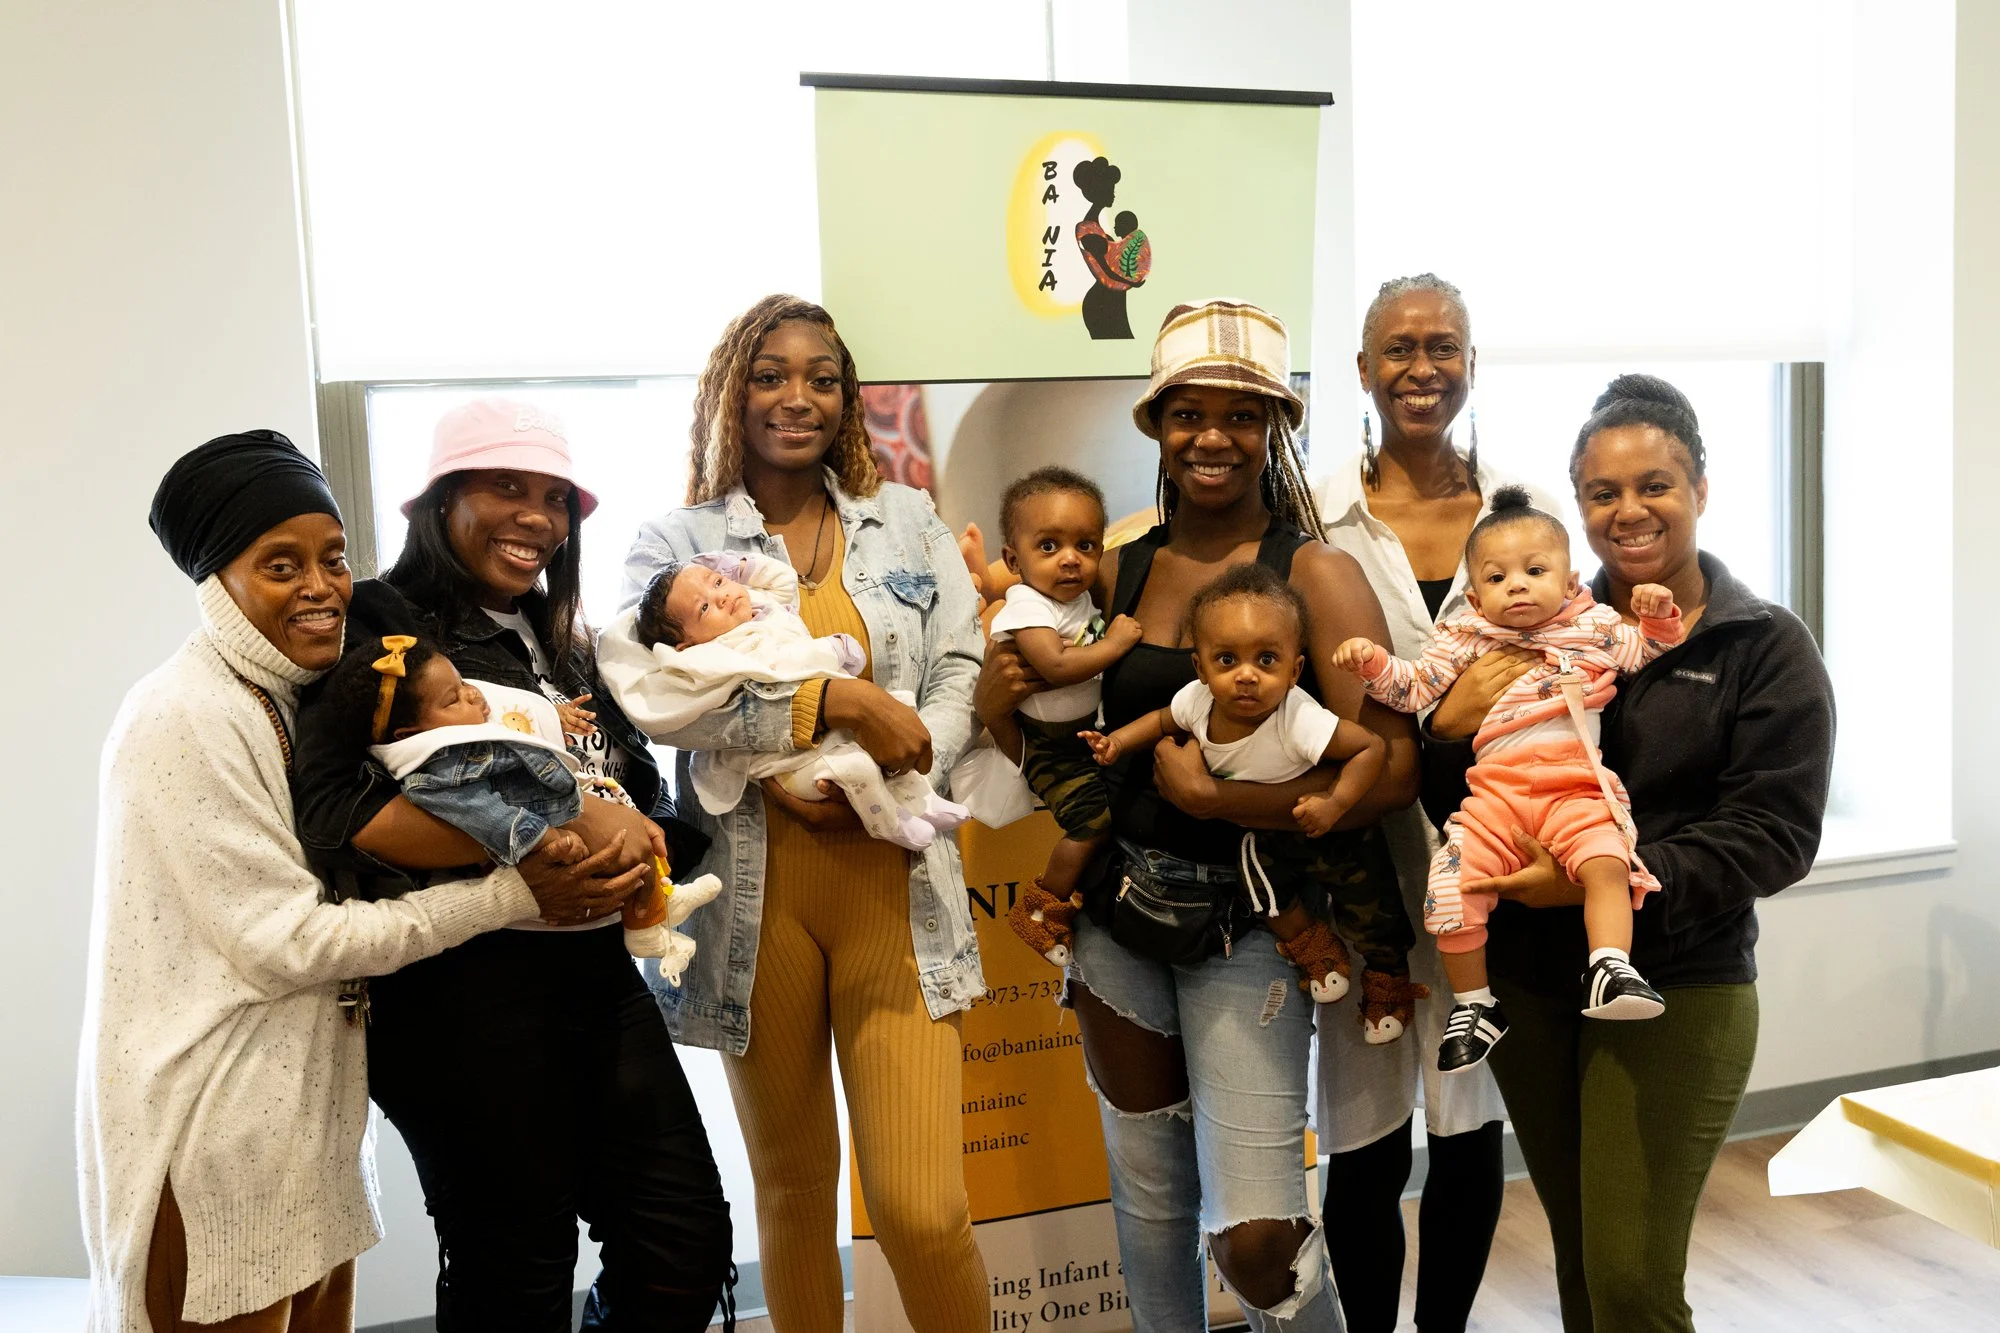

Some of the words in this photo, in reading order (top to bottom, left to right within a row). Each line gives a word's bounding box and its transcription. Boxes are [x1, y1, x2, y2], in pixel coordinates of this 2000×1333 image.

[1041, 160, 1060, 205] BA
[1038, 225, 1061, 292] NIA
[989, 1276, 1031, 1300] ing
[1039, 1259, 1110, 1289] Infant
[1040, 1299, 1090, 1323] One
